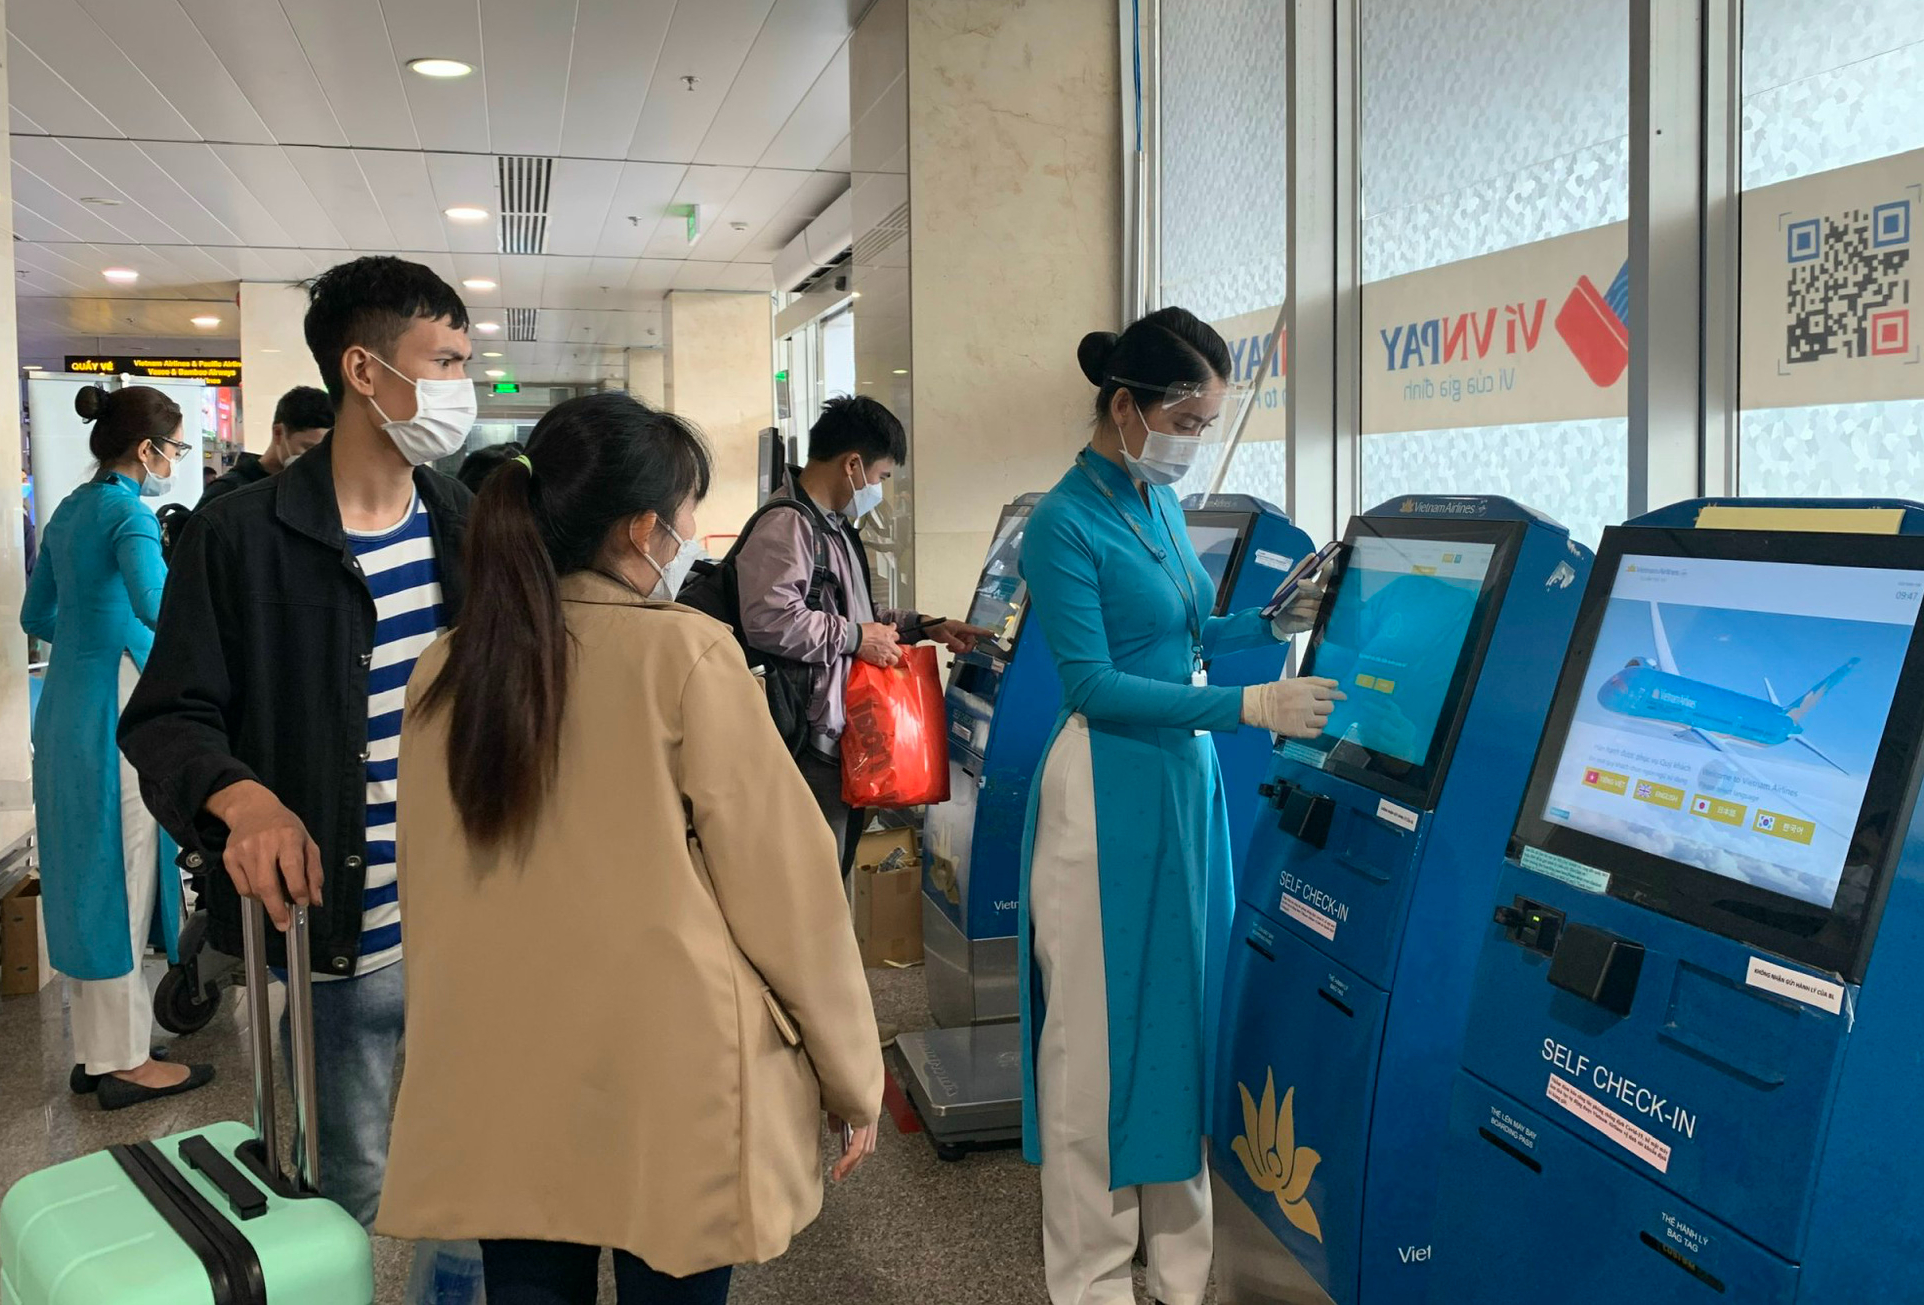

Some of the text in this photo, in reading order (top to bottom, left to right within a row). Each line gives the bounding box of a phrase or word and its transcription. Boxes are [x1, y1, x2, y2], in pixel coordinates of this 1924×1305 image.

[178, 368, 208, 376] Bamboo
[208, 369, 236, 377] Airways
[1414, 501, 1475, 514] Vietnam Airlines
[1896, 591, 1918, 601] 09:47
[1733, 775, 1741, 783] to
[1742, 775, 1771, 791] Vietnam
[1770, 784, 1799, 798] Airlines
[1280, 870, 1303, 893] SELF
[1303, 884, 1349, 922] CHECK-IN
[1541, 1038, 1590, 1077] SELF
[1593, 1065, 1697, 1139] CHECK-IN
[1490, 1116, 1534, 1149] BOARDING PASS
[1666, 1227, 1699, 1253] BAG TAG
